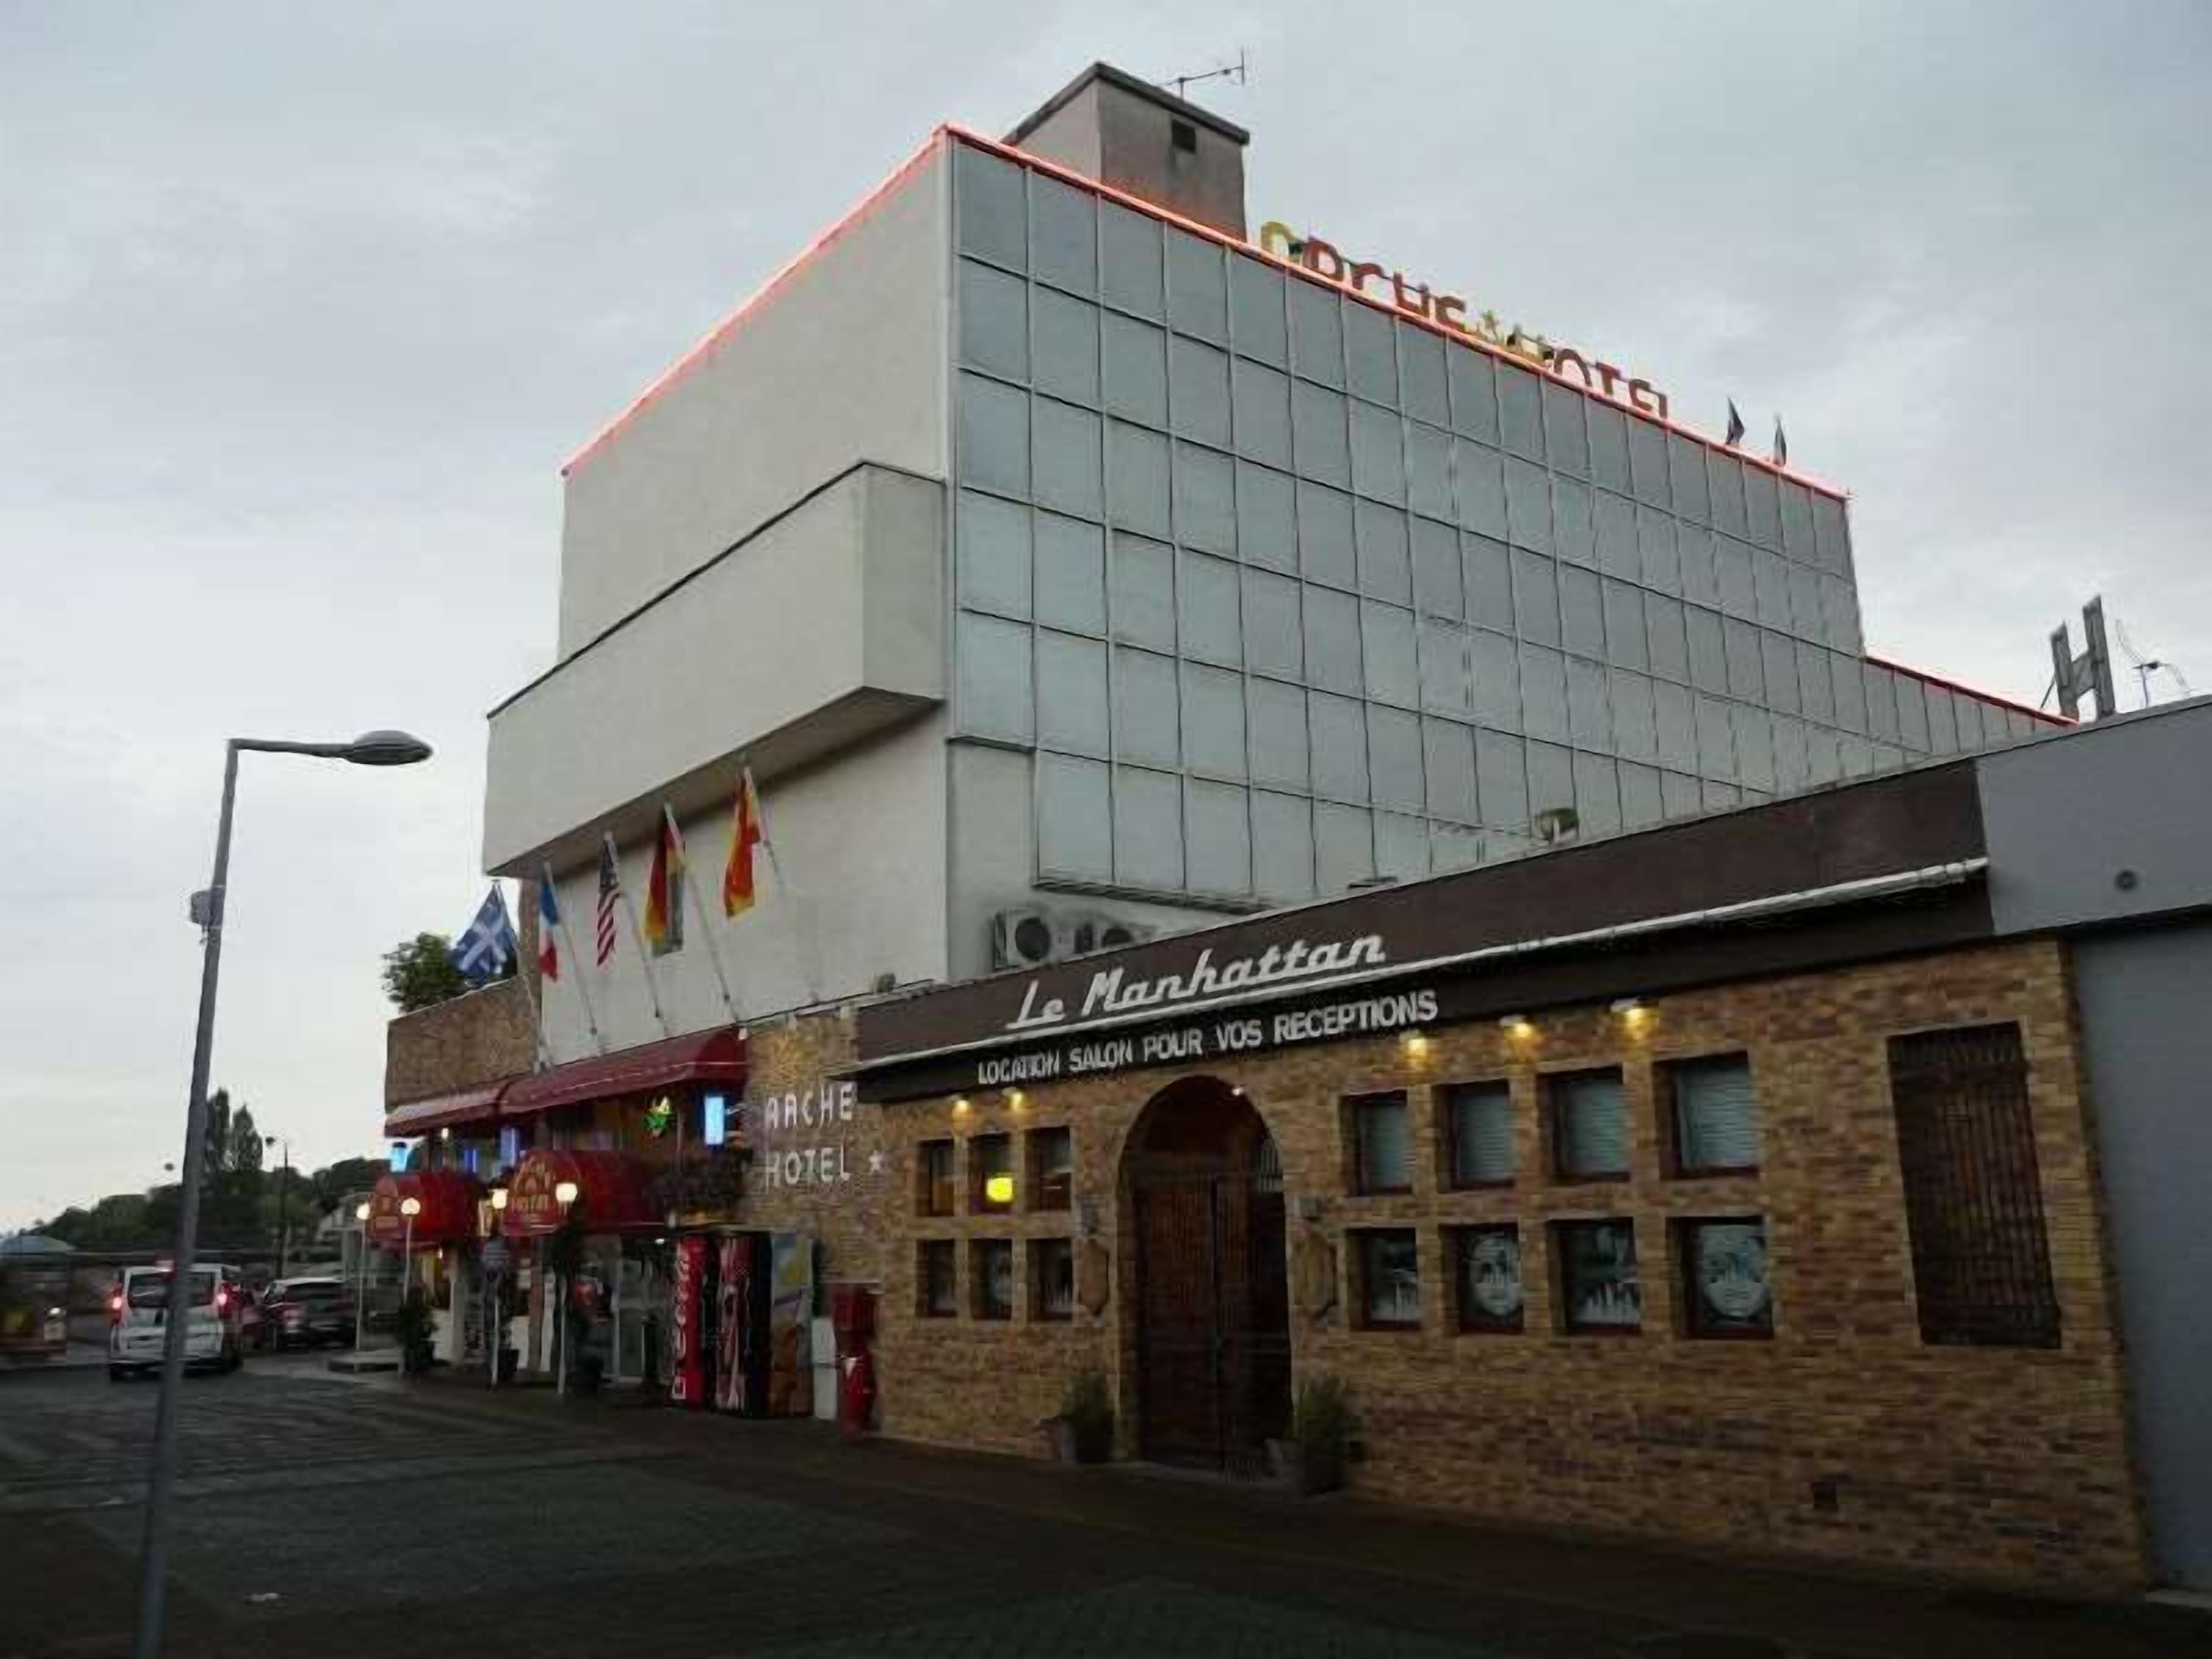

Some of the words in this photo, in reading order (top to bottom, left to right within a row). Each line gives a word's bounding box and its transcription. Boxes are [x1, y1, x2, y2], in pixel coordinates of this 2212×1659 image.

[1006, 979, 1066, 1030] Le
[1080, 934, 1387, 1017] Manhattan
[978, 1049, 1060, 1085] LOCATION
[1069, 1038, 1134, 1072] SALON
[1143, 1027, 1204, 1062] POUR
[1215, 1019, 1263, 1051] VOS
[1273, 989, 1438, 1044] RECEPTIONS
[765, 1147, 851, 1193] HOTEL
